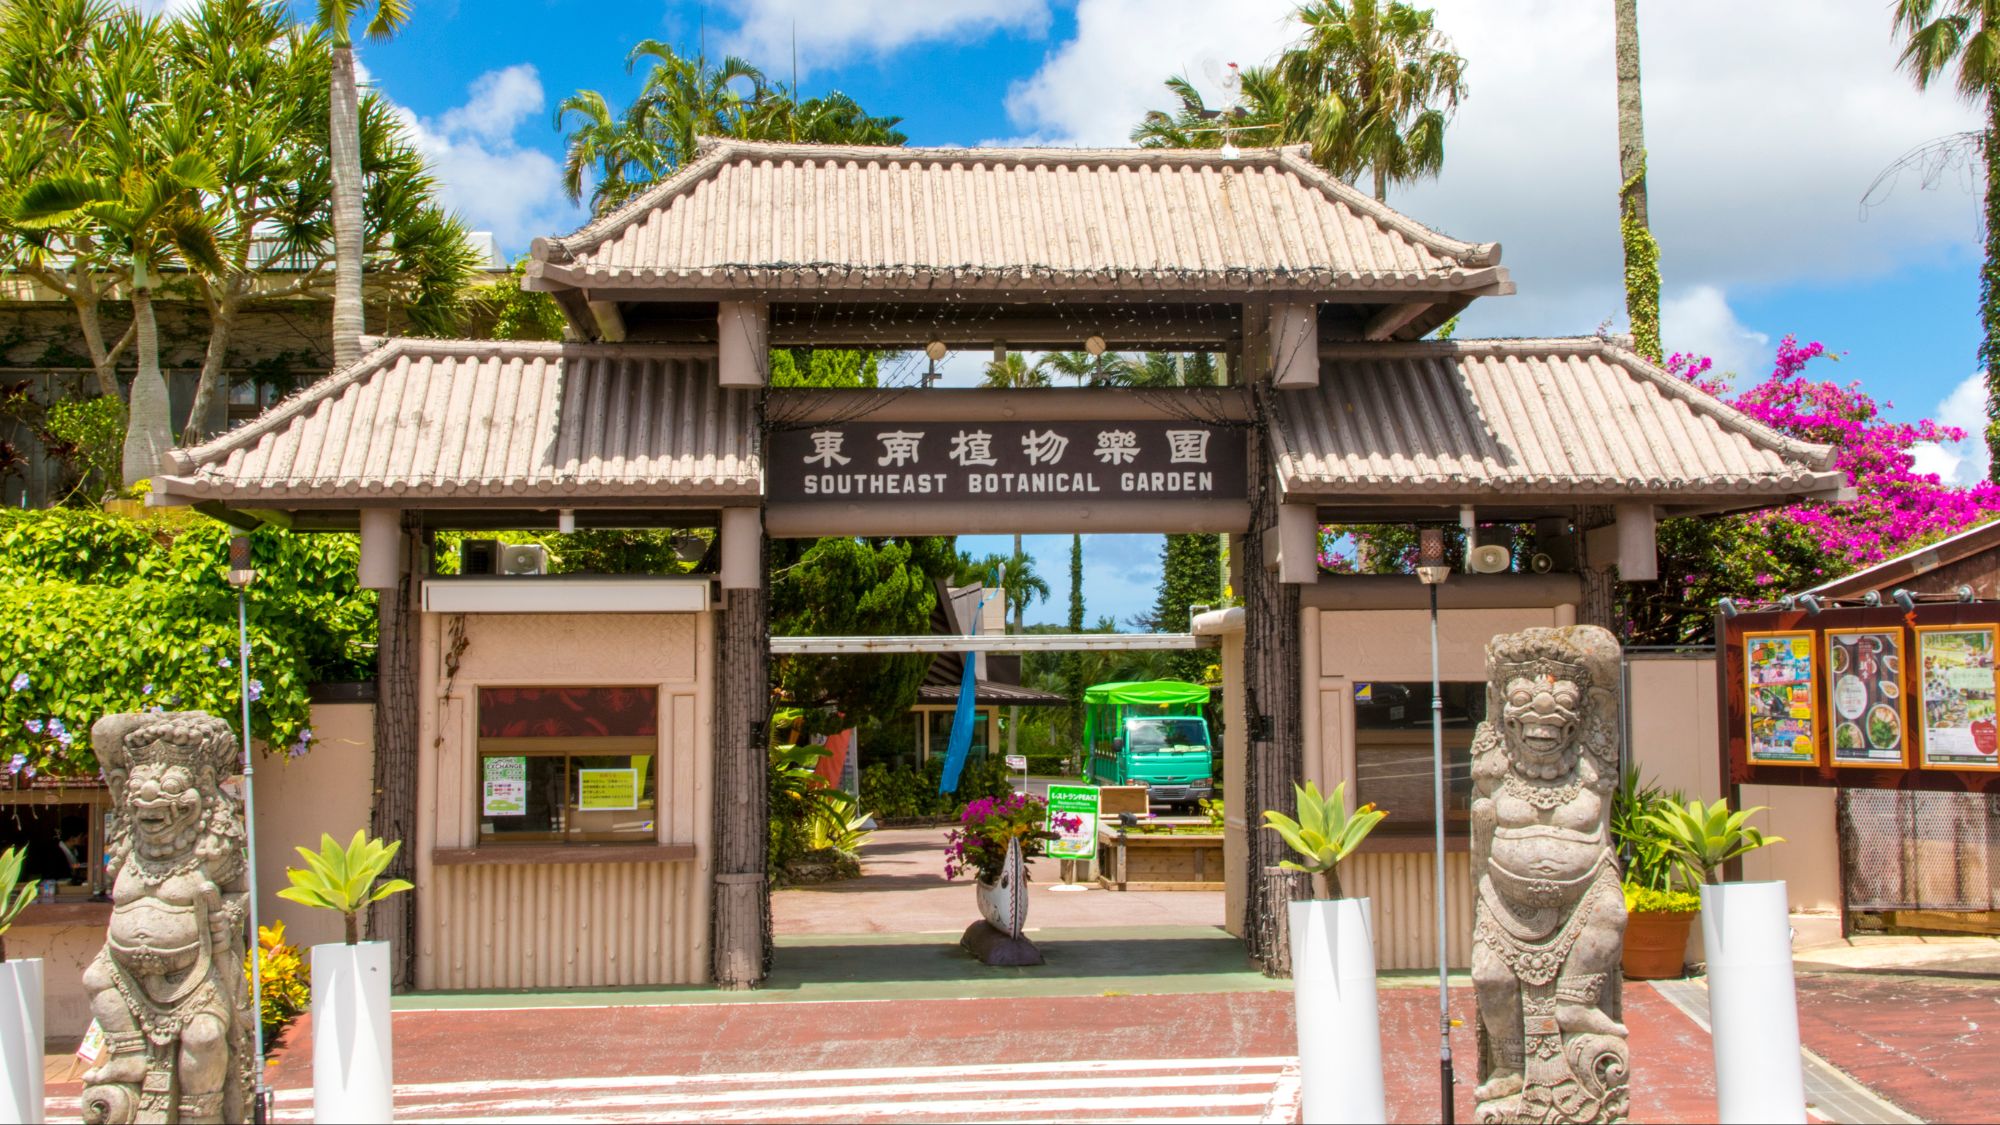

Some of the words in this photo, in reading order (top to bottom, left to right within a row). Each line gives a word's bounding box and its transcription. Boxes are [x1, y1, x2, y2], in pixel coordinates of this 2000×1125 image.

[803, 473, 948, 494] SOUTHEAST
[968, 472, 1101, 493] BOTANICAL
[1120, 471, 1213, 492] GARDEN
[1051, 792, 1097, 801] レストランPEACE
